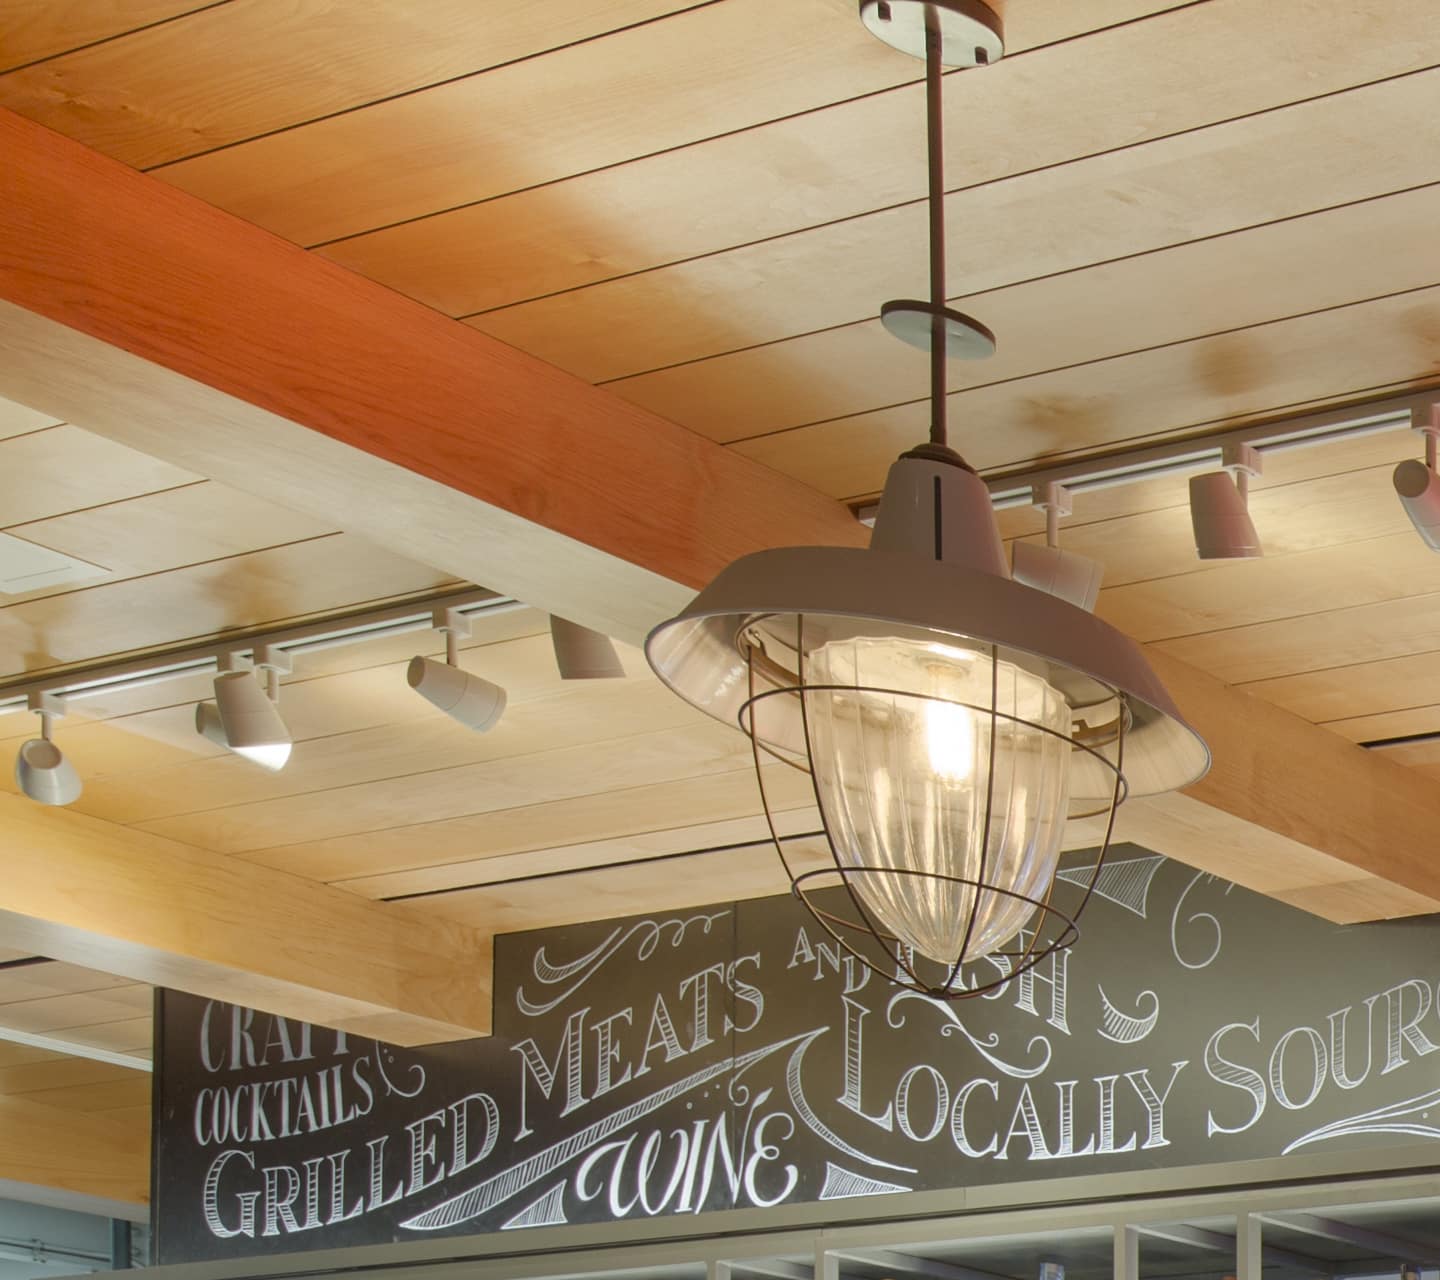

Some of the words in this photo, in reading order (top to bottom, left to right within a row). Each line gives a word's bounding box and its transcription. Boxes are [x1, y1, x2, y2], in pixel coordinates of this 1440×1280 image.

[787, 926, 871, 994] AND
[195, 1056, 373, 1146] COCKTAILS
[203, 1091, 500, 1239] GRILLED
[509, 950, 766, 1141] MEATS
[837, 993, 1188, 1161] LOCALLY
[574, 1087, 798, 1220] WINE
